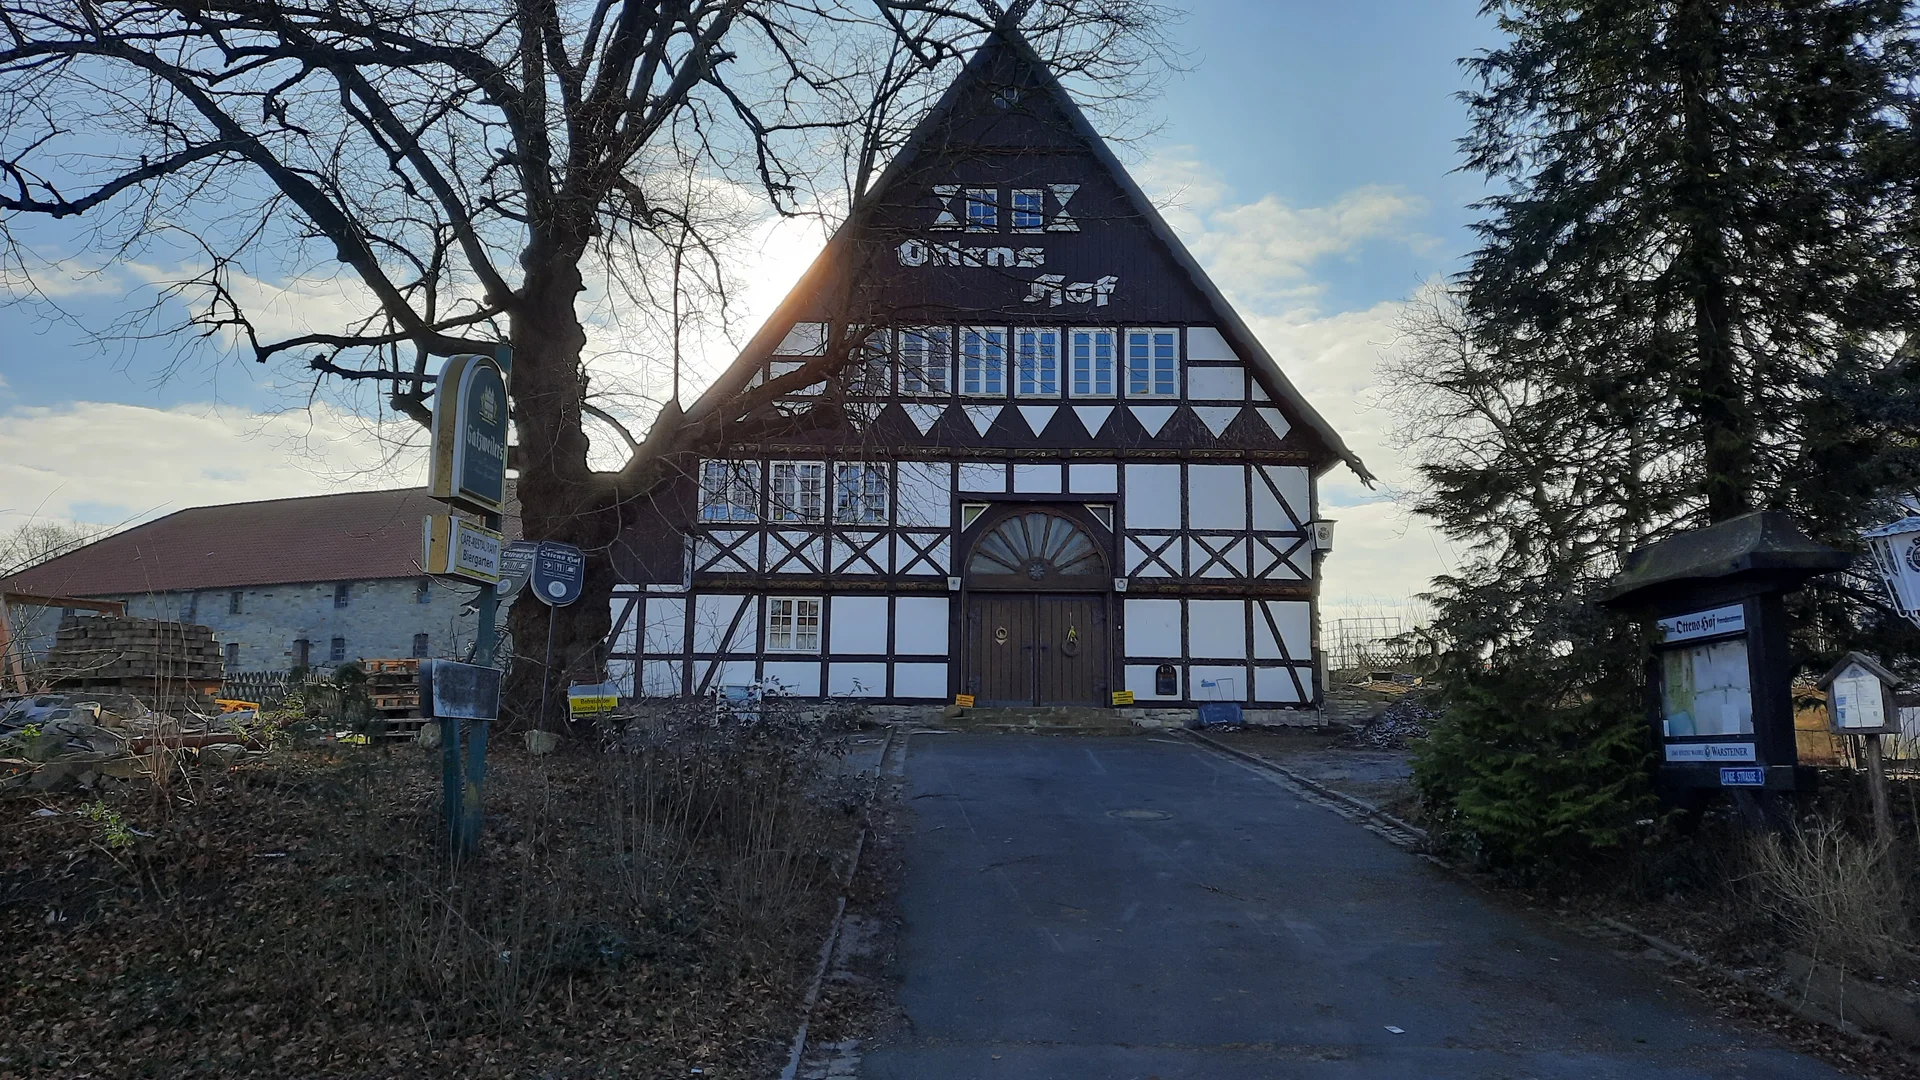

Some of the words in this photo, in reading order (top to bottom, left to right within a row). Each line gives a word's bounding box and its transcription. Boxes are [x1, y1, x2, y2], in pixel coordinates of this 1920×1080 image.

[1022, 273, 1119, 308] Hof
[462, 549, 494, 569] Biergarten
[1676, 619, 1701, 635] Ottens
[1711, 746, 1749, 757] WARSTEINER
